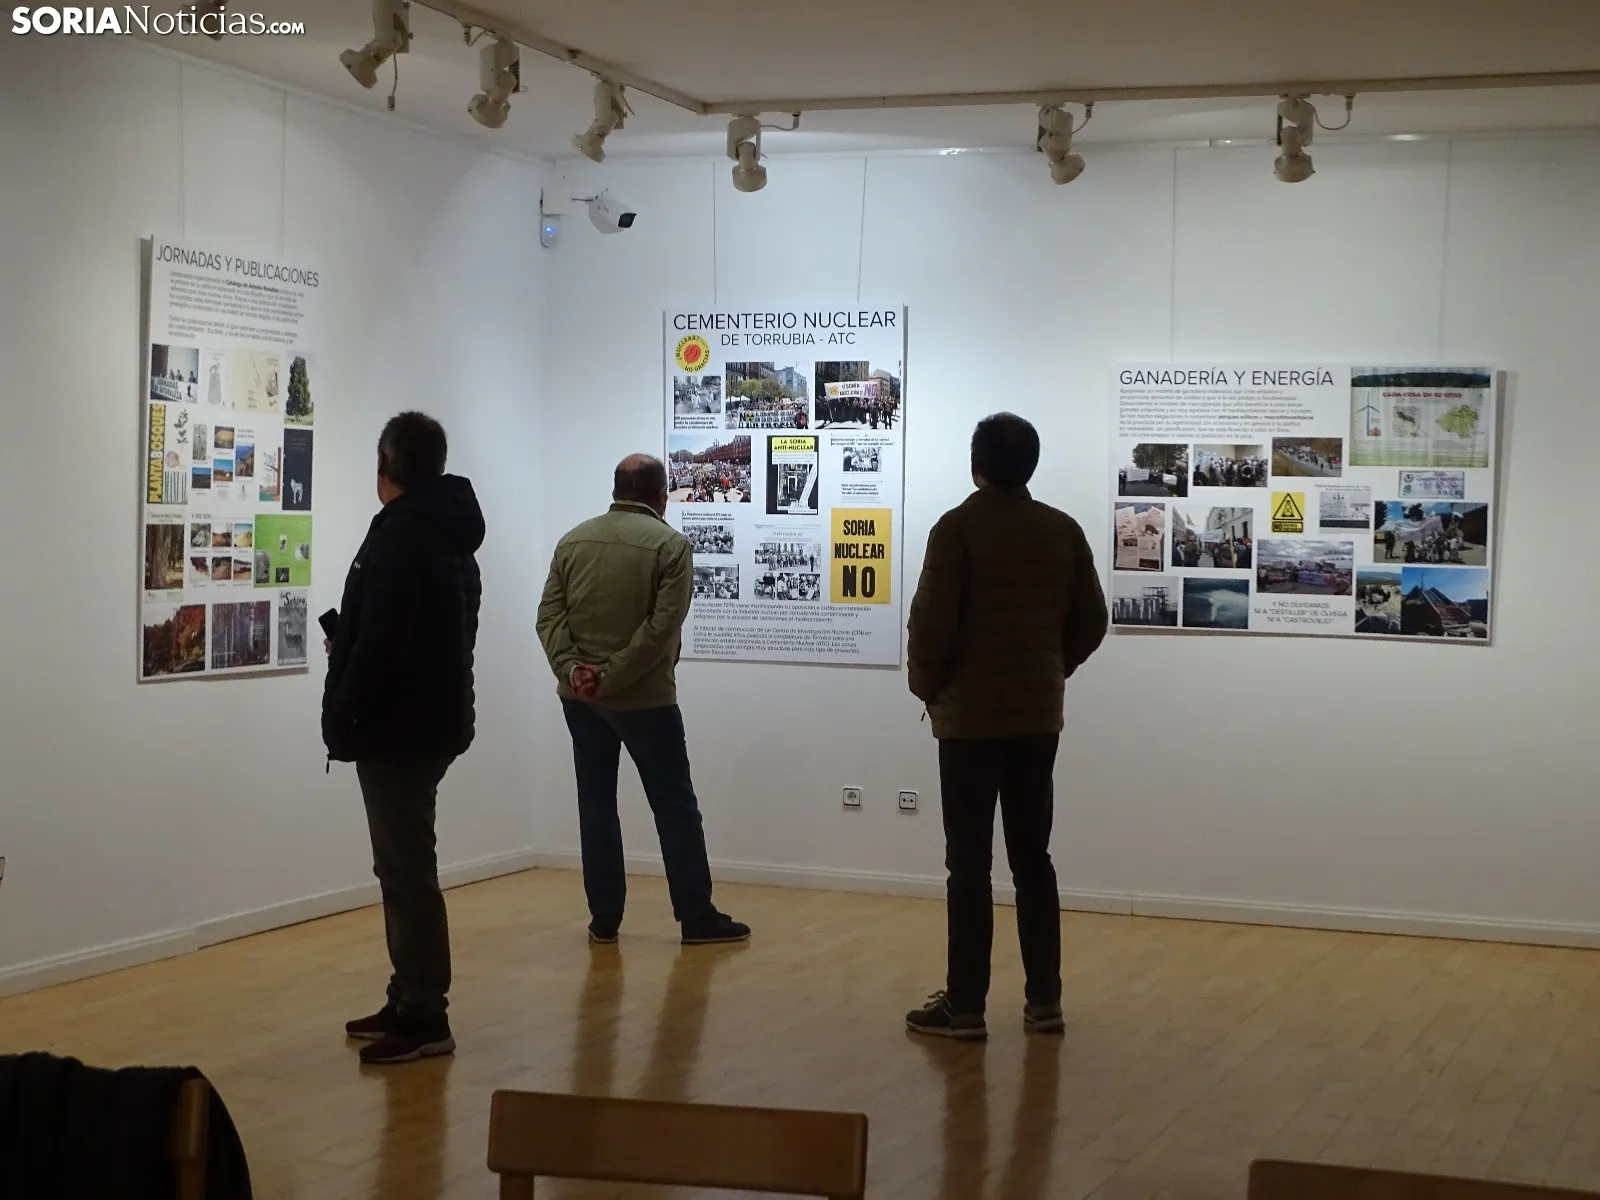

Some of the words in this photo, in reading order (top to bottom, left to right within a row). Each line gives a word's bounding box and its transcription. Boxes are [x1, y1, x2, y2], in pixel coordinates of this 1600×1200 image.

[156, 245, 221, 271] JORNADAS
[225, 256, 232, 272] Y
[235, 258, 319, 287] PUBLICACIONES
[673, 312, 797, 331] CEMENTERIO
[804, 311, 896, 328] NUCLEAR
[721, 333, 740, 346] DE
[744, 332, 815, 346] TORRUBIA
[828, 332, 856, 345] ATC
[694, 349, 710, 372] GRACIAS
[1119, 367, 1228, 386] GANADERÍA
[1234, 371, 1246, 385] Y
[1252, 367, 1334, 386] ENERGÍA
[843, 519, 876, 537] SORIA
[834, 543, 885, 560] NUCLEAR
[842, 565, 876, 598] NO
